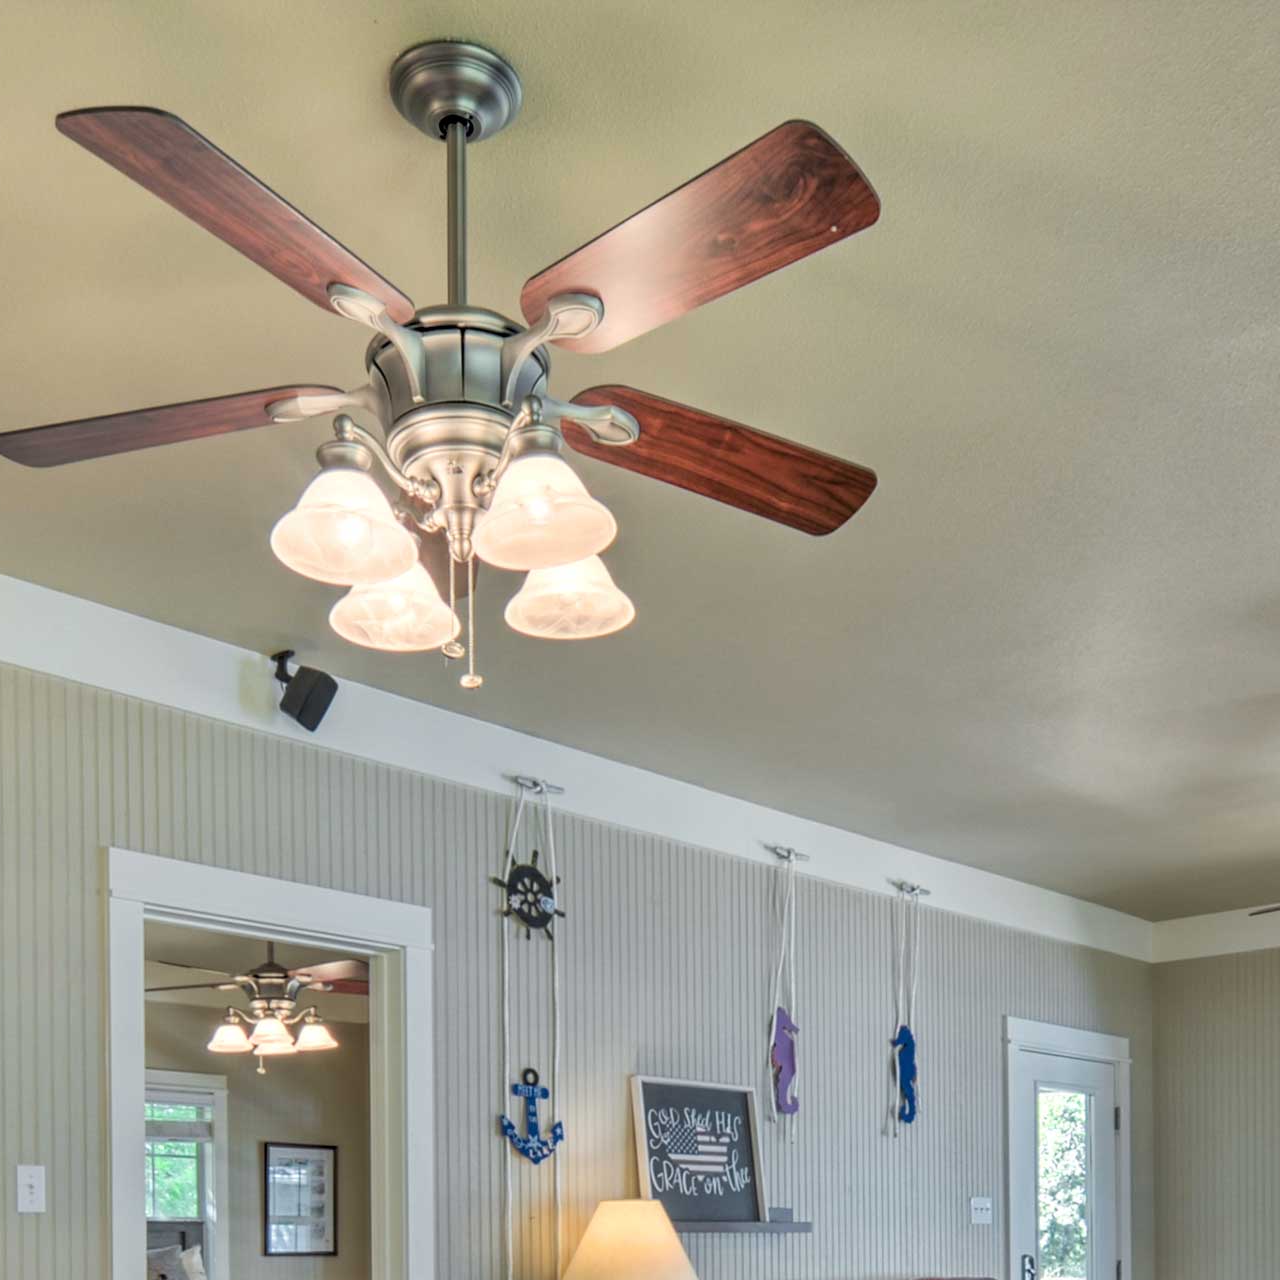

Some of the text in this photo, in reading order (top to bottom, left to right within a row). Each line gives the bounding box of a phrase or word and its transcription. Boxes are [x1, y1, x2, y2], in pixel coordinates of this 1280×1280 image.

[648, 1107, 680, 1149] GOD
[715, 1111, 741, 1141] HIS
[650, 1149, 750, 1196] GRACE on thee
